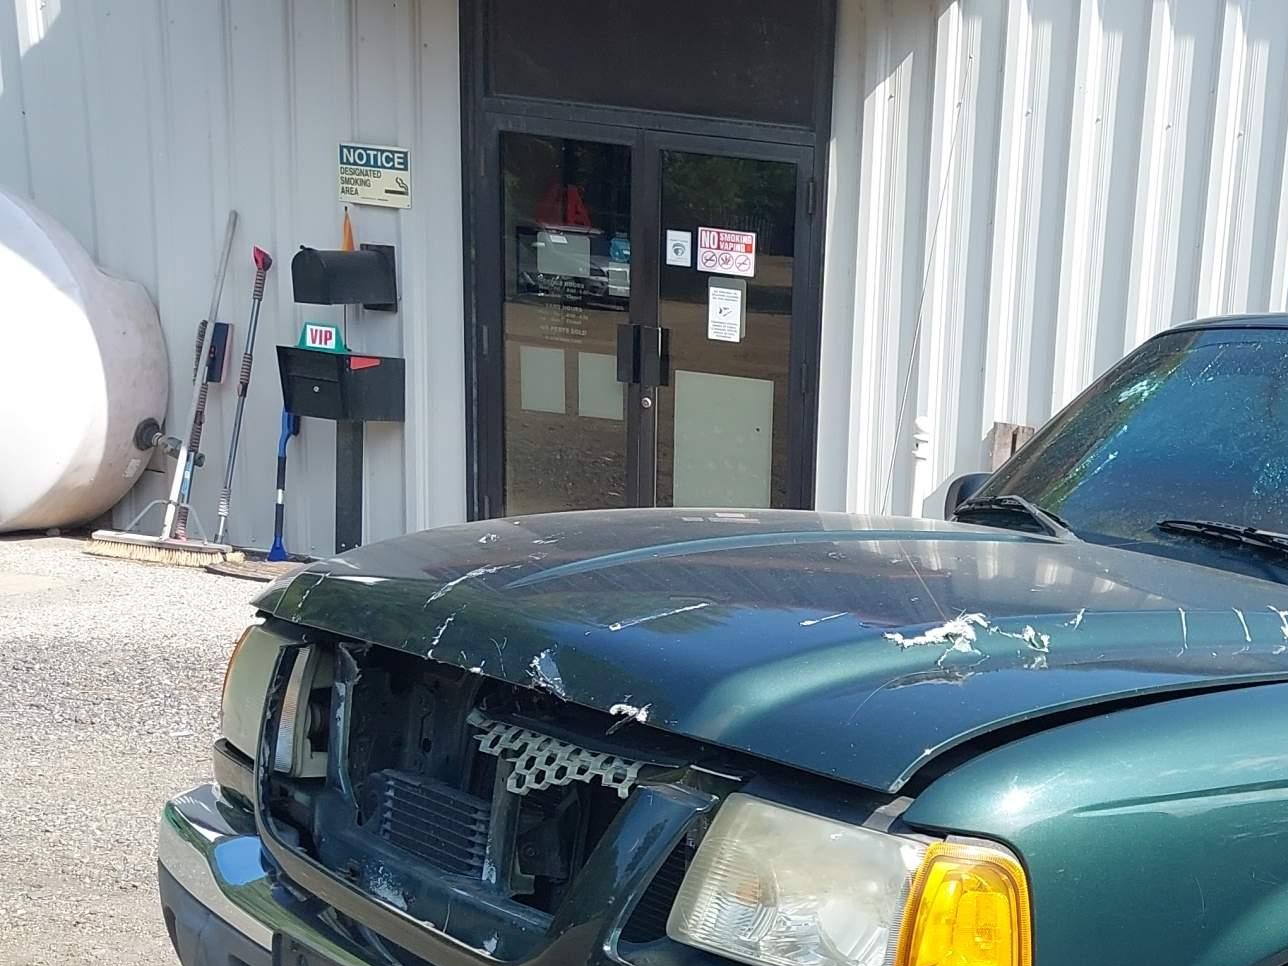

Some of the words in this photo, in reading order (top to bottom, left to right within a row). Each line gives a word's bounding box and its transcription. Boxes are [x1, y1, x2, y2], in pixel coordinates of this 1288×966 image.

[343, 148, 405, 169] NOTICE
[340, 166, 382, 179] DESIGNATED
[340, 176, 371, 188] SMOKING
[340, 186, 359, 196] AREA
[701, 230, 718, 249] NO
[310, 328, 333, 346] VIP
